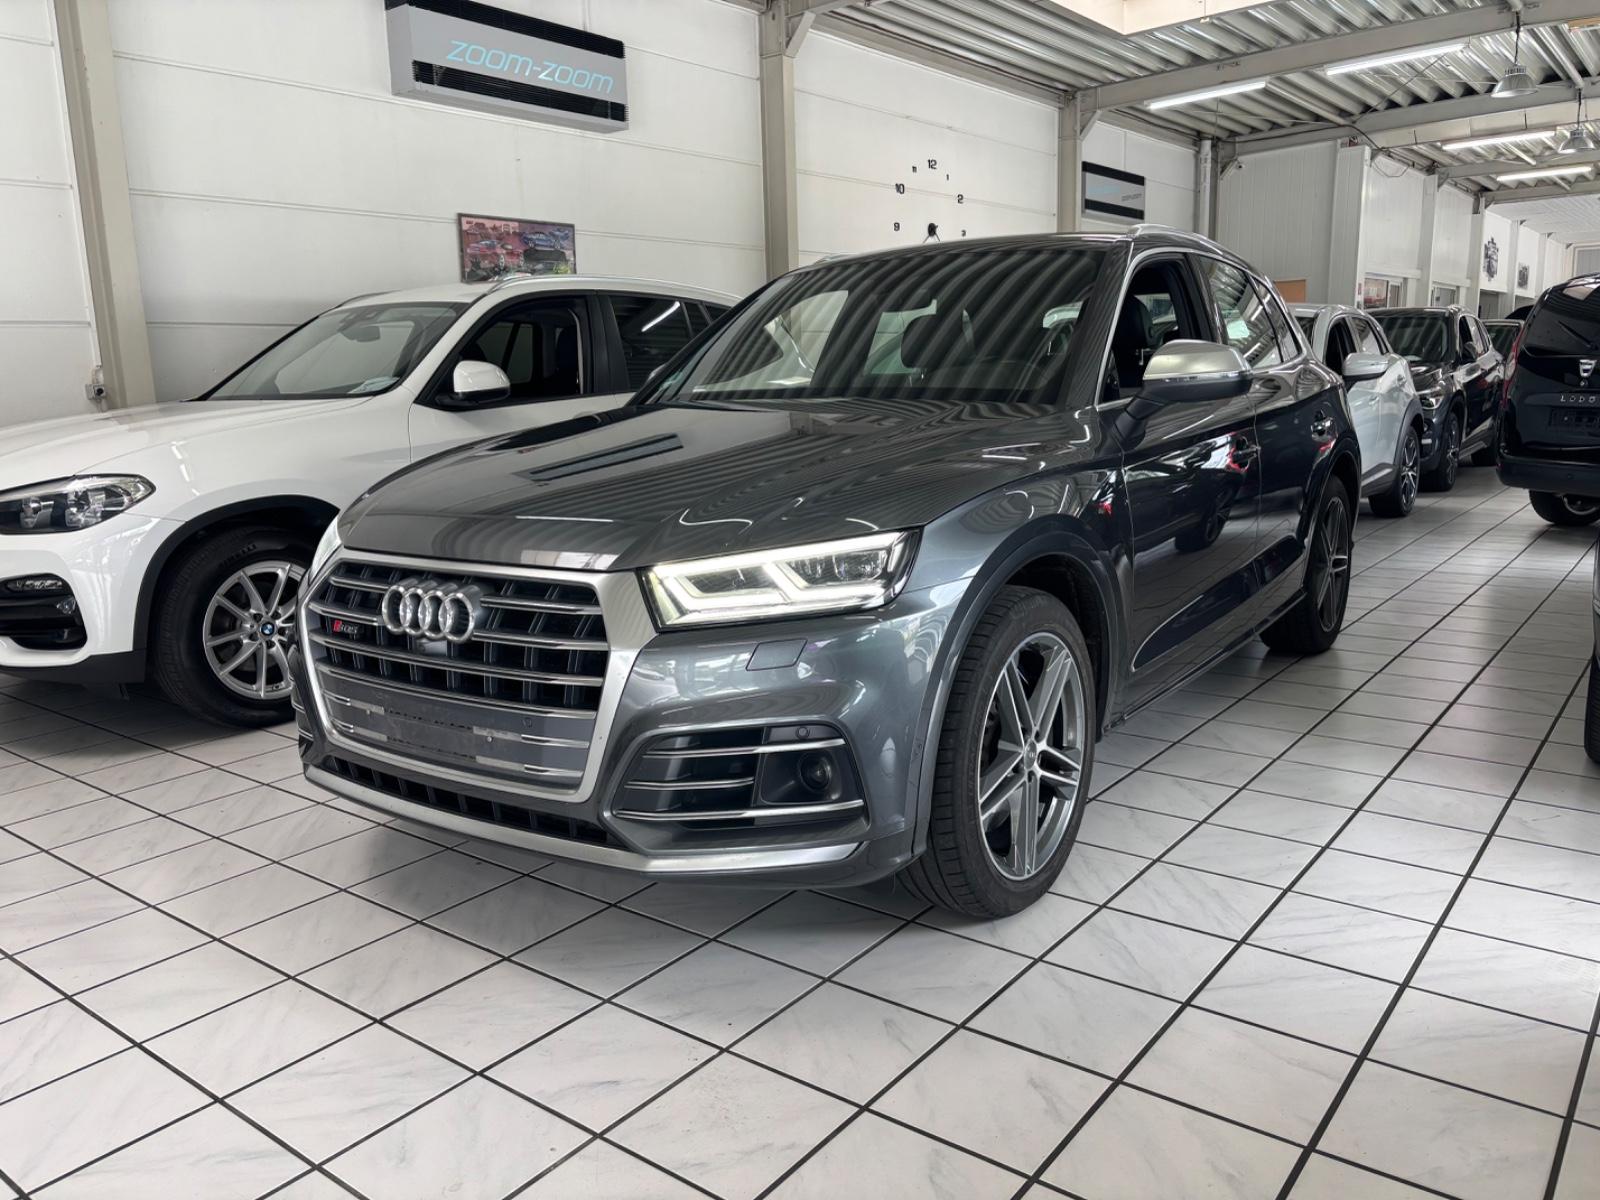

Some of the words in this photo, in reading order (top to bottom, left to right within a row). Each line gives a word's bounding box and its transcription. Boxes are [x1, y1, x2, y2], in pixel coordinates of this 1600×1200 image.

[446, 40, 614, 94] zoom-zoom
[928, 159, 937, 170] 12
[895, 183, 905, 194] 10
[957, 193, 964, 204] 2
[893, 222, 900, 231] 9
